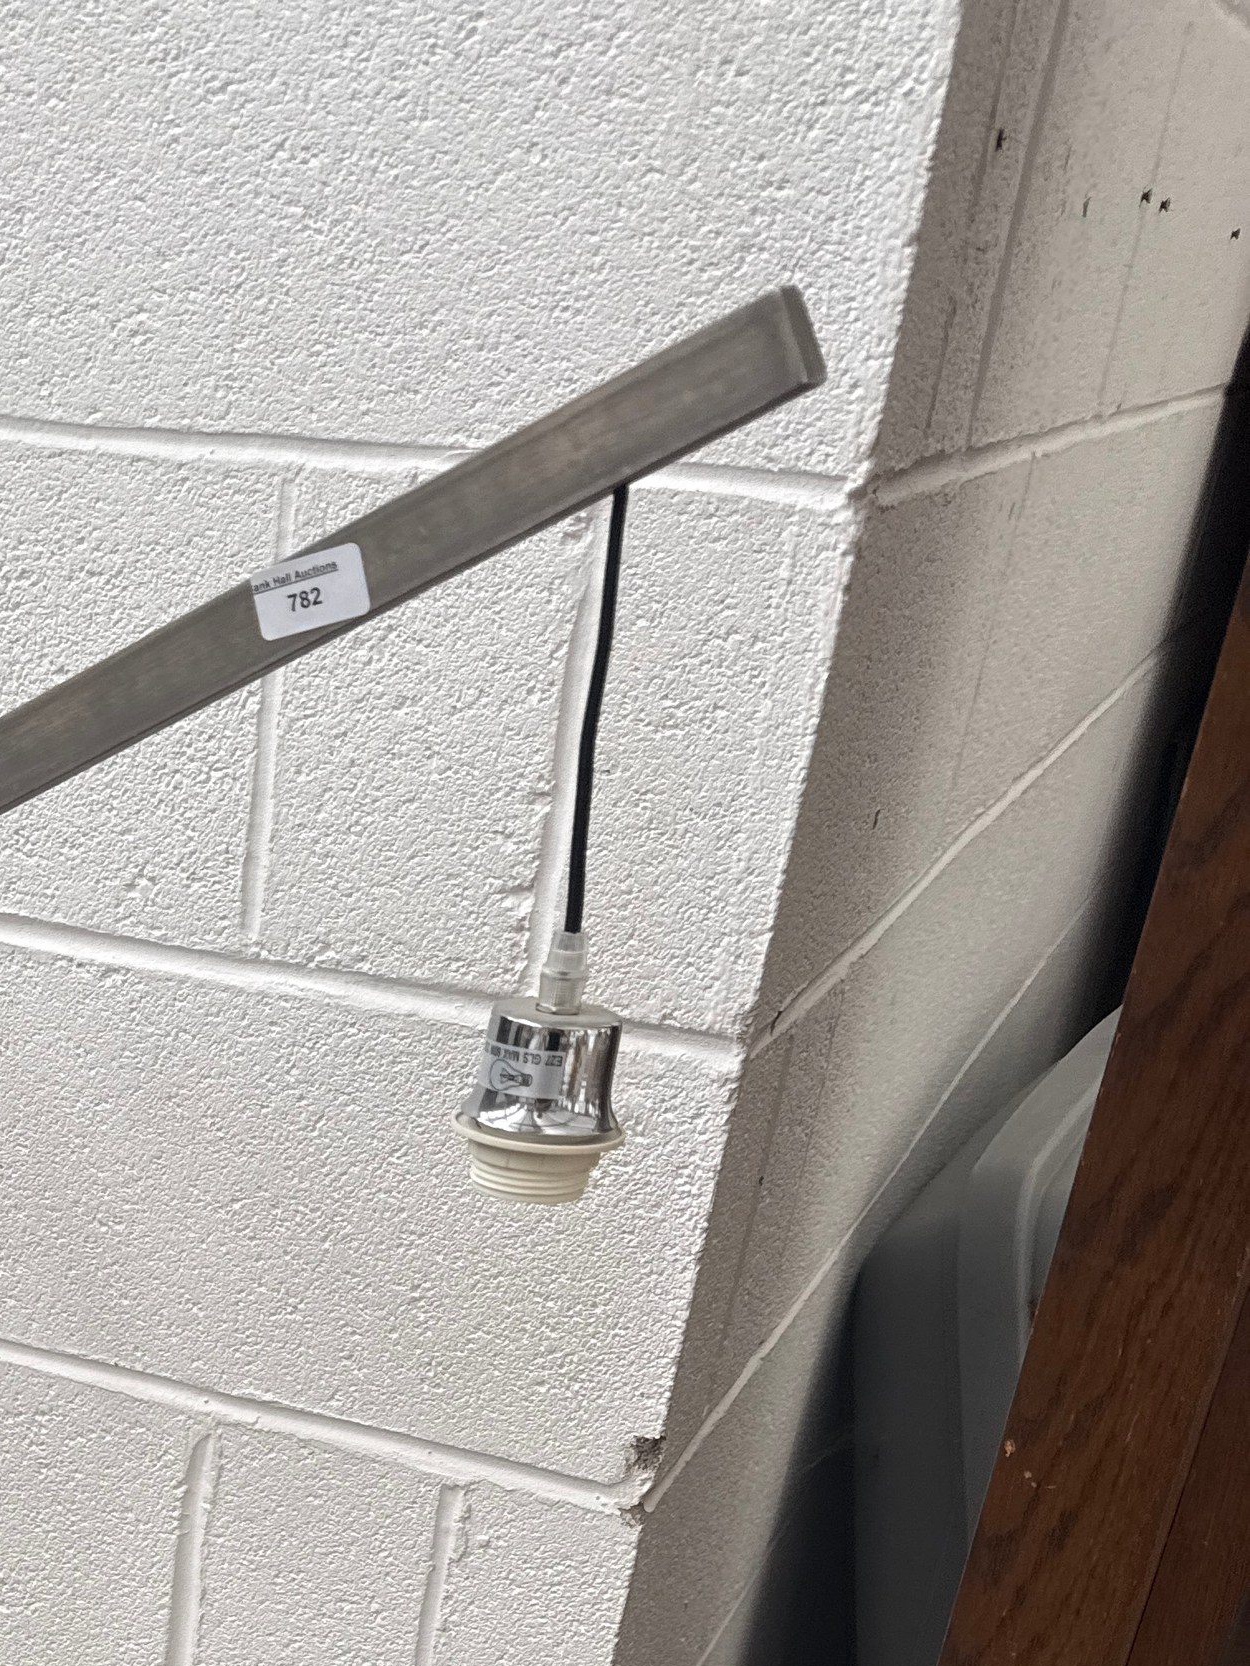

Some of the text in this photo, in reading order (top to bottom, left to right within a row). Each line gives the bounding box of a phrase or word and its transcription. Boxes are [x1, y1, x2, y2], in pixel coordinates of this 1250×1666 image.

[252, 561, 338, 592] ank Hall Auctions
[287, 587, 323, 612] 782
[503, 1048, 520, 1062] MAX
[523, 1052, 541, 1065] GLS
[545, 1055, 563, 1067] E27
